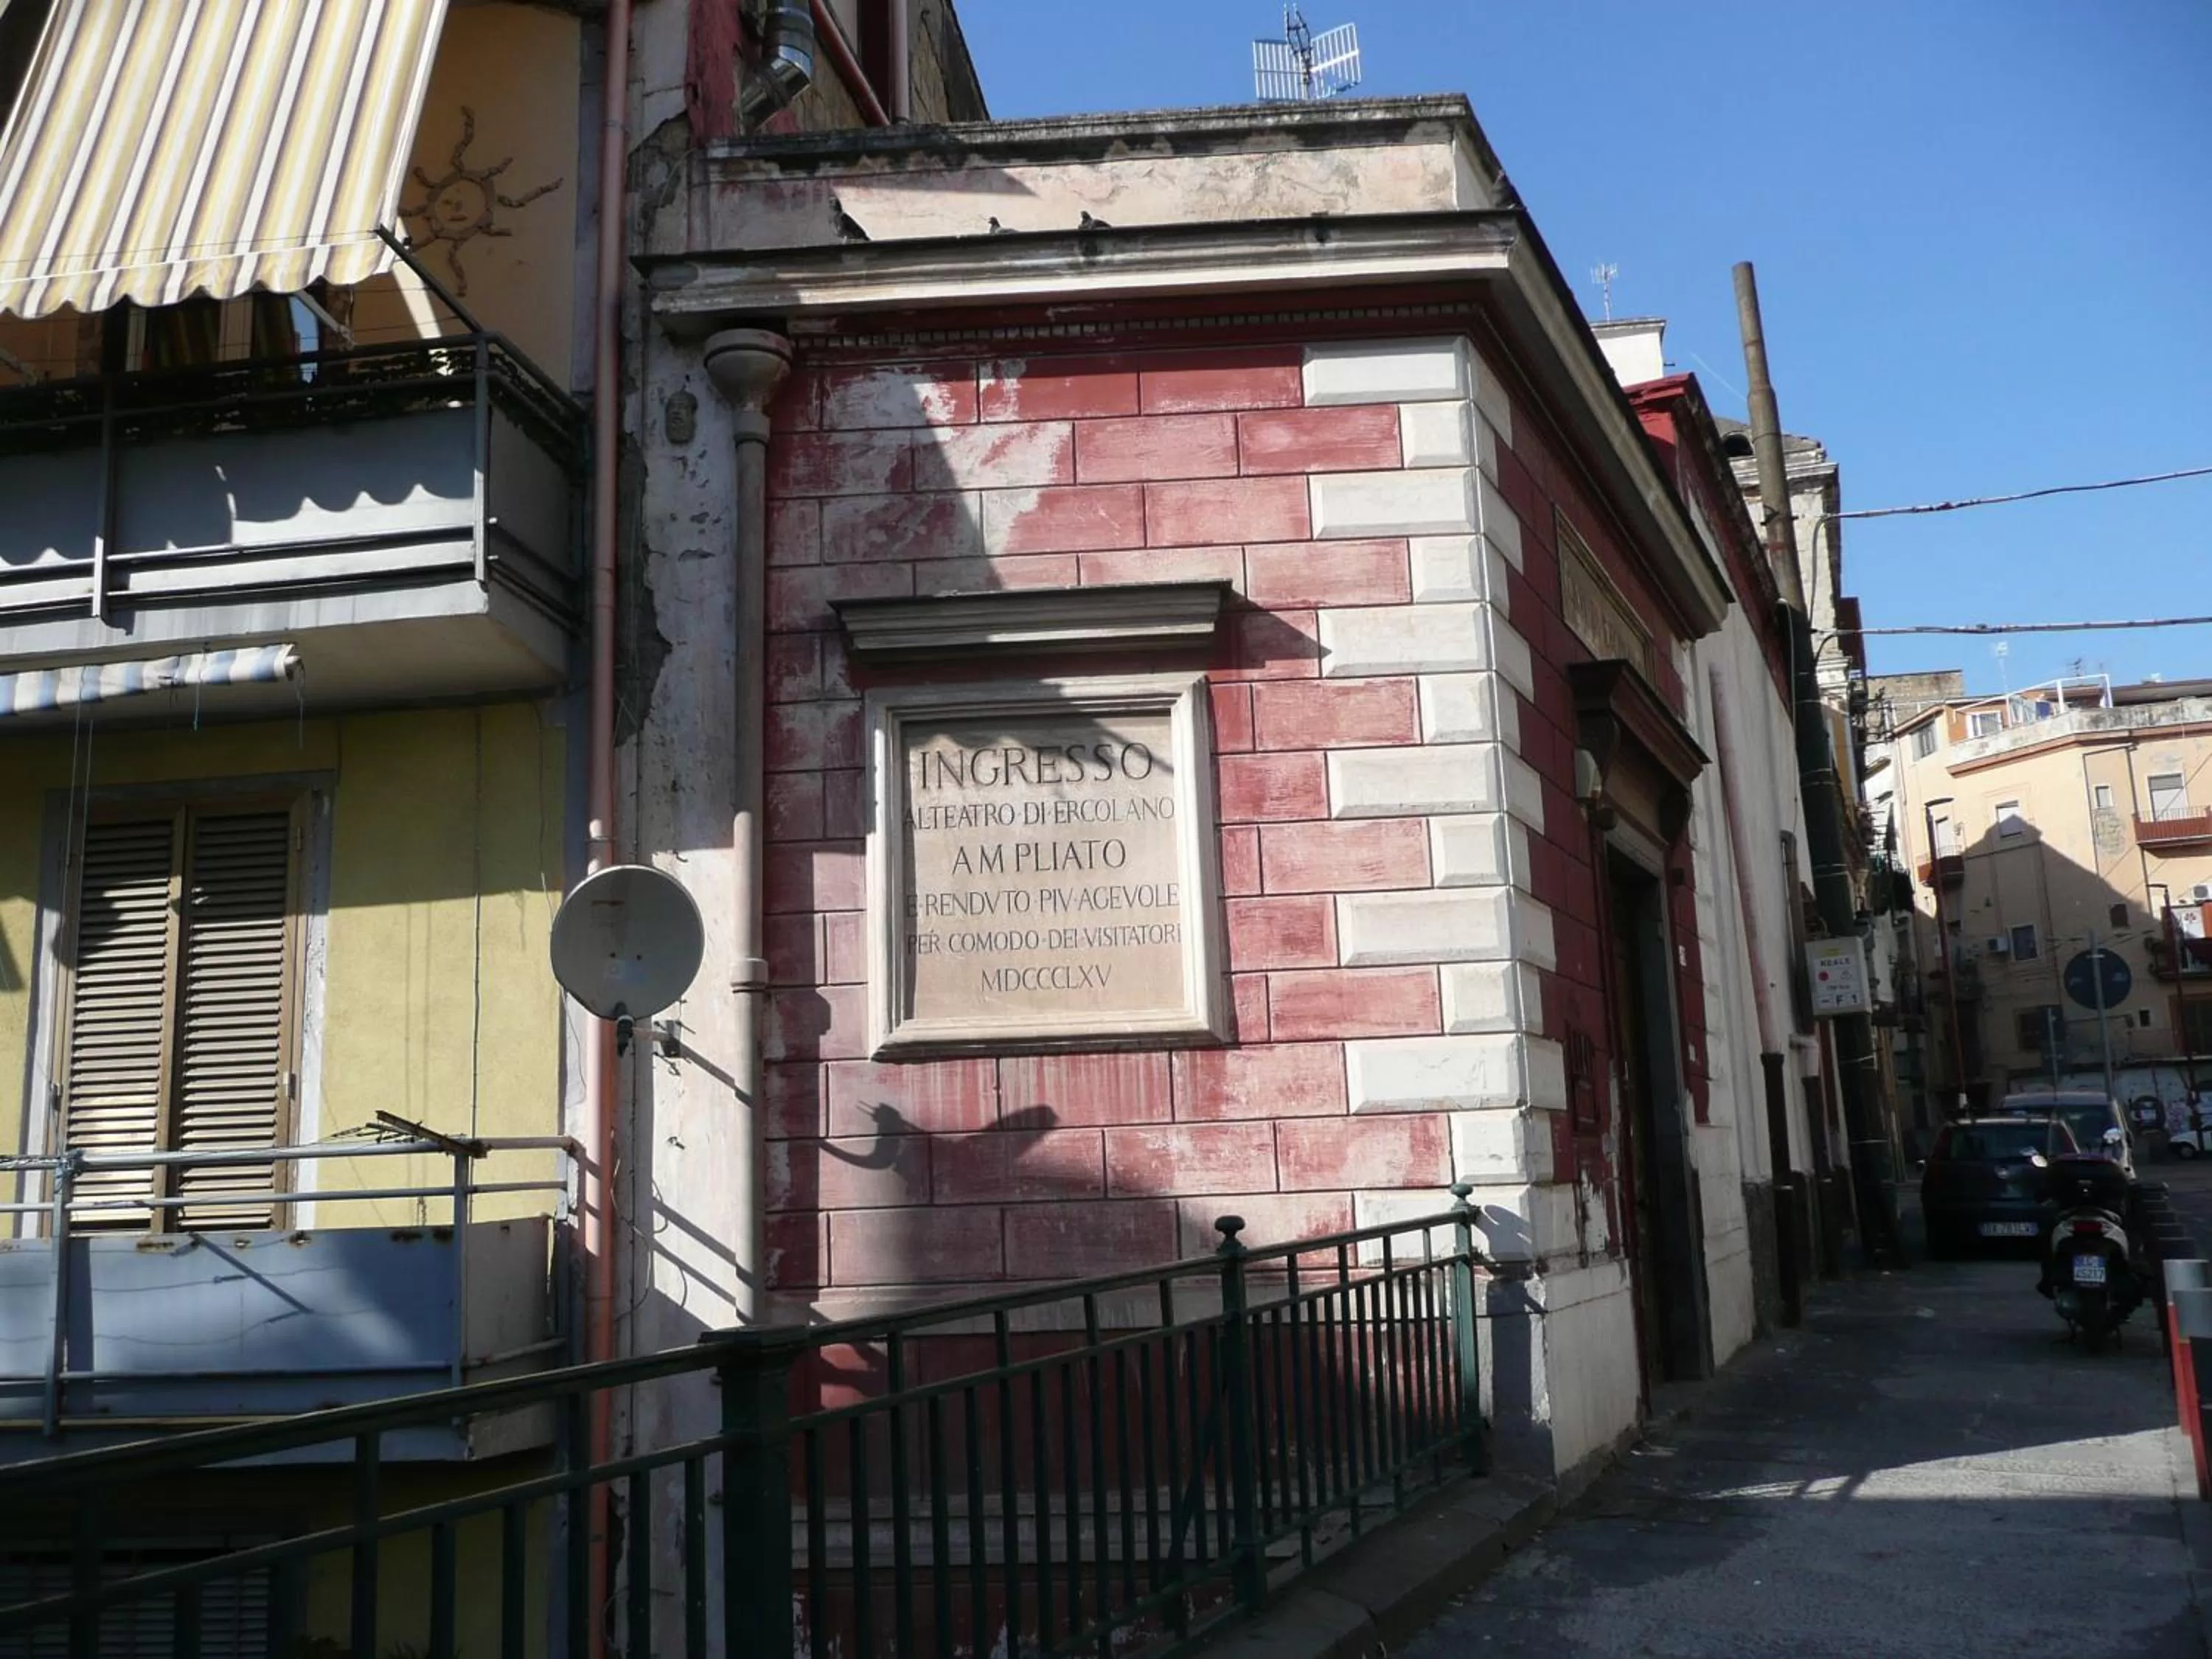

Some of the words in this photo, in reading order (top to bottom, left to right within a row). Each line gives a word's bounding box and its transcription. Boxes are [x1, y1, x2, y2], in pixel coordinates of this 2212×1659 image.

[920, 742, 1153, 790] INGRESSO
[1023, 801, 1045, 825] DI
[1054, 796, 1175, 824] ERCOLANO
[952, 838, 1126, 874] AMPLIATO
[925, 890, 1030, 917] RENDVTO
[1040, 888, 1074, 915] PIV
[1078, 883, 1180, 912] AGEVOLE
[949, 930, 1039, 953] COMODO
[1048, 928, 1078, 950] DEI
[981, 964, 1112, 992] MDCCCLXV
